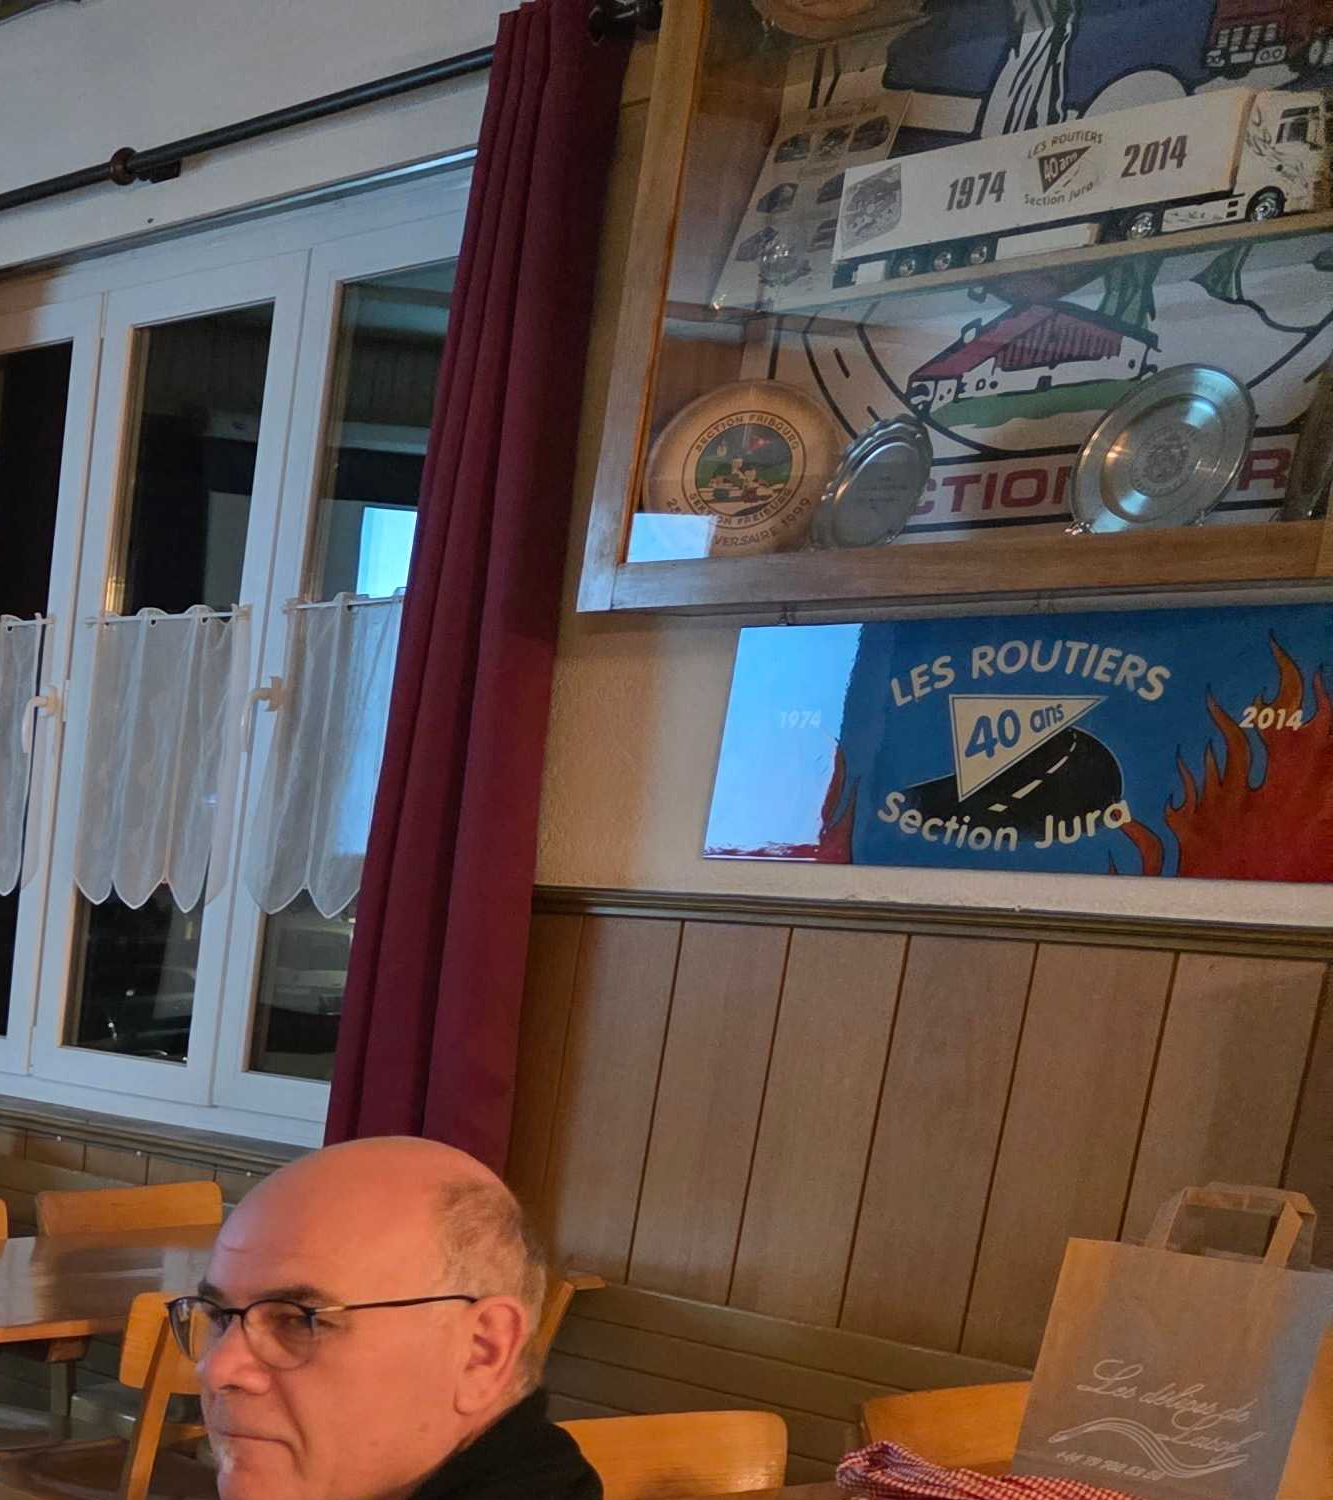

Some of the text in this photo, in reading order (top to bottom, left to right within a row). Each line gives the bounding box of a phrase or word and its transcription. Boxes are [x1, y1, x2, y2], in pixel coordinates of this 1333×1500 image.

[1044, 156, 1060, 183] 40
[1121, 135, 1189, 179] 2014
[946, 170, 1007, 212] 1974
[1024, 193, 1065, 208] Section
[694, 414, 798, 452] SECTION FRIBOURG
[891, 640, 1171, 707] LES ROUTIERS
[779, 710, 822, 729] 1974
[964, 704, 1065, 758] 40 ans
[1239, 704, 1304, 731] 2014
[877, 791, 1131, 851] Section Jura
